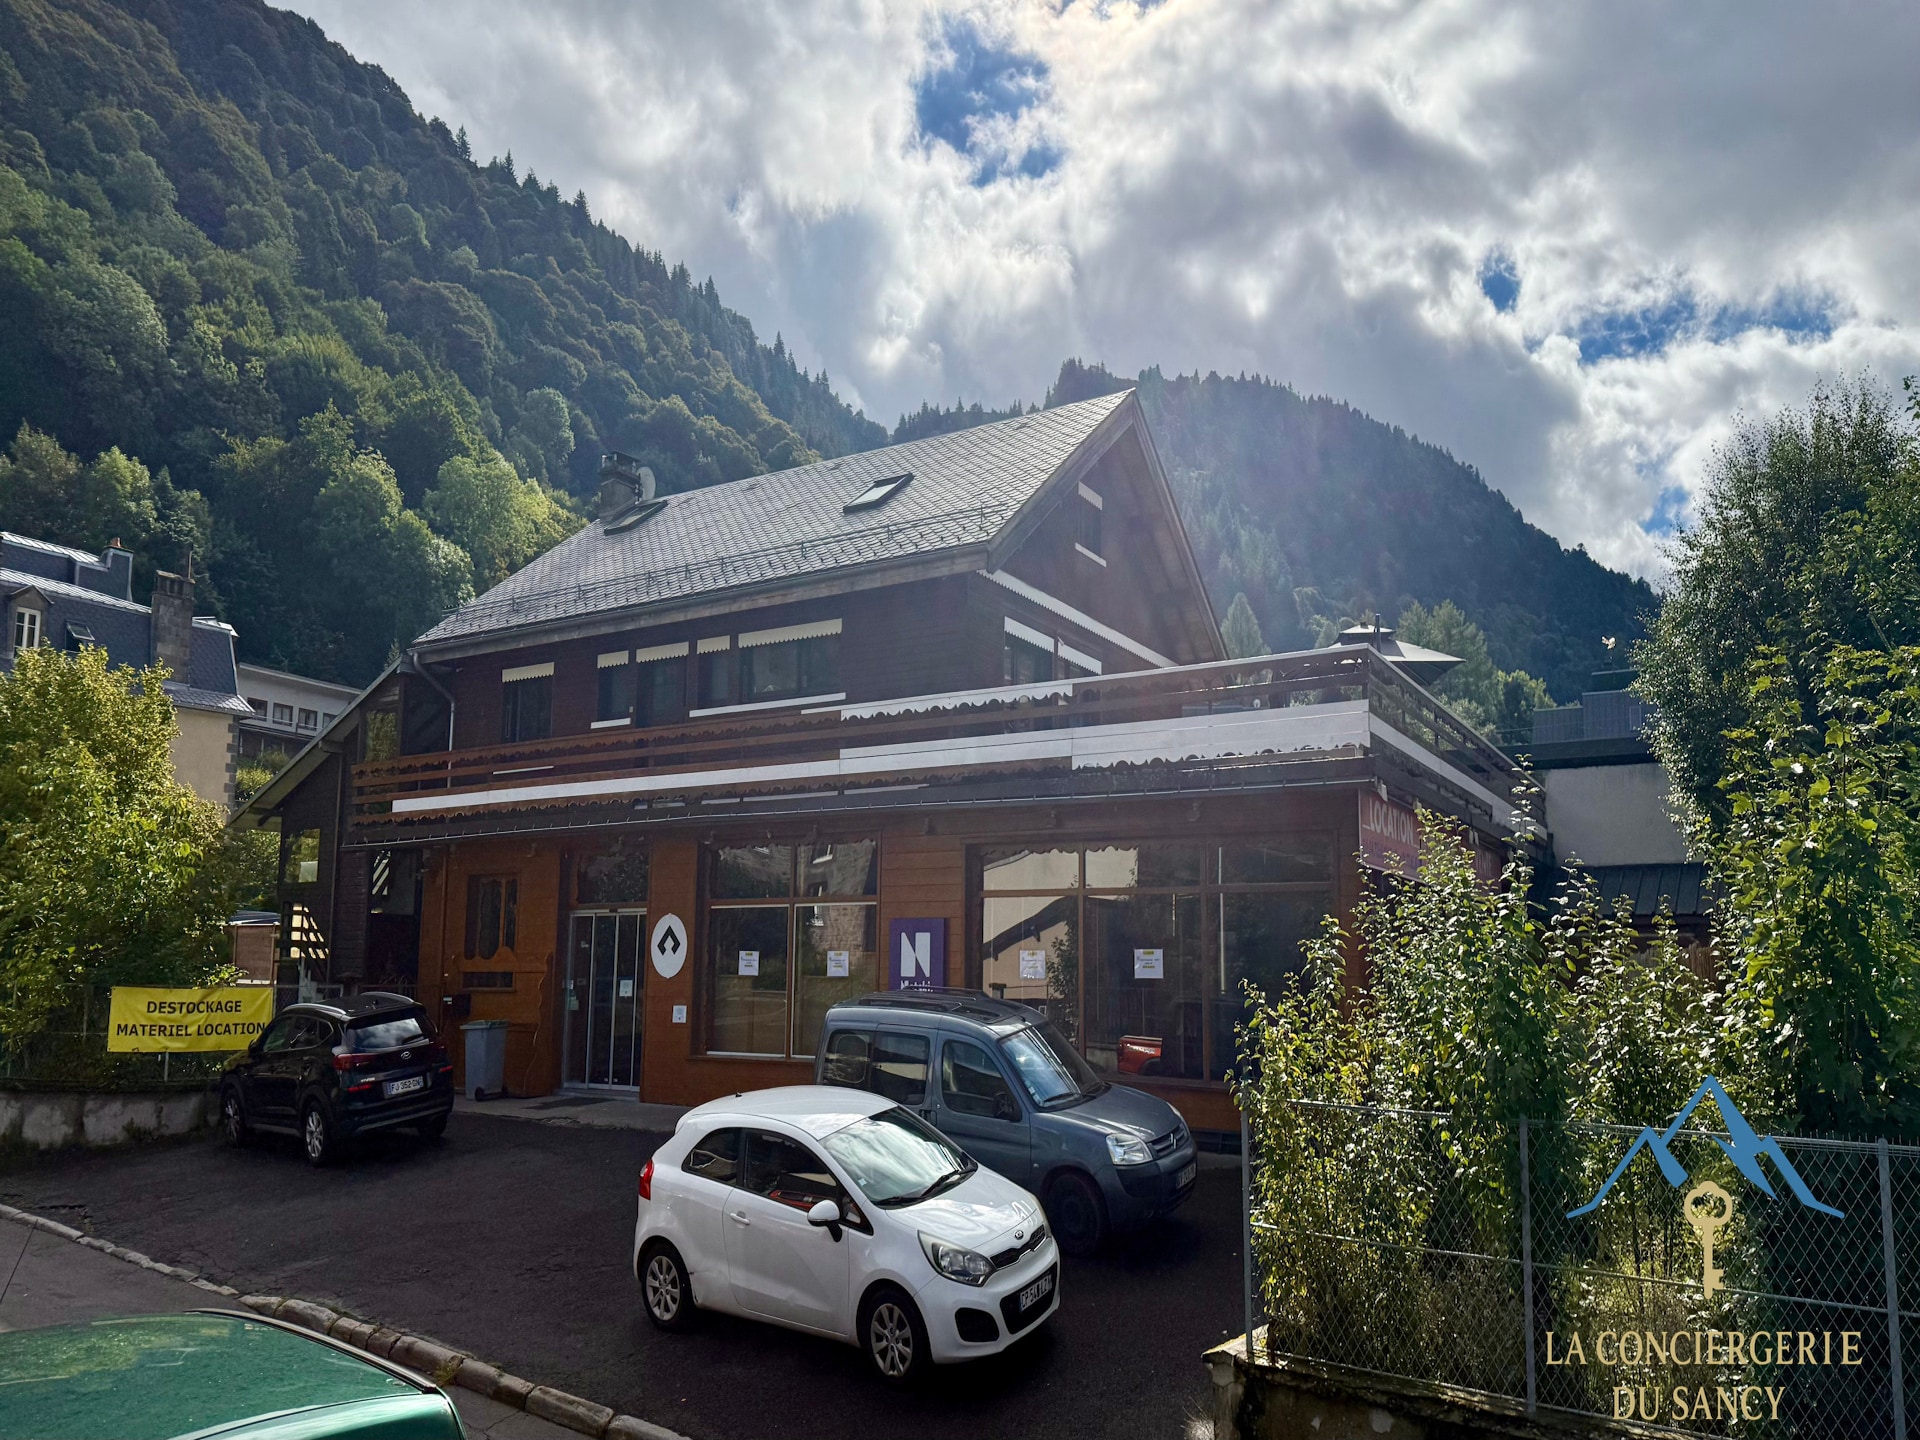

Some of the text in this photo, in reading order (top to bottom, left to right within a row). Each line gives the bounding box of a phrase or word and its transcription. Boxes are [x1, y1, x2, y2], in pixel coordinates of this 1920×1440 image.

[1369, 799, 1414, 846] LOCATION
[900, 932, 931, 977] N
[146, 1000, 242, 1014] DESTOCKAGE
[116, 1022, 265, 1037] MATERIEL LOCATION
